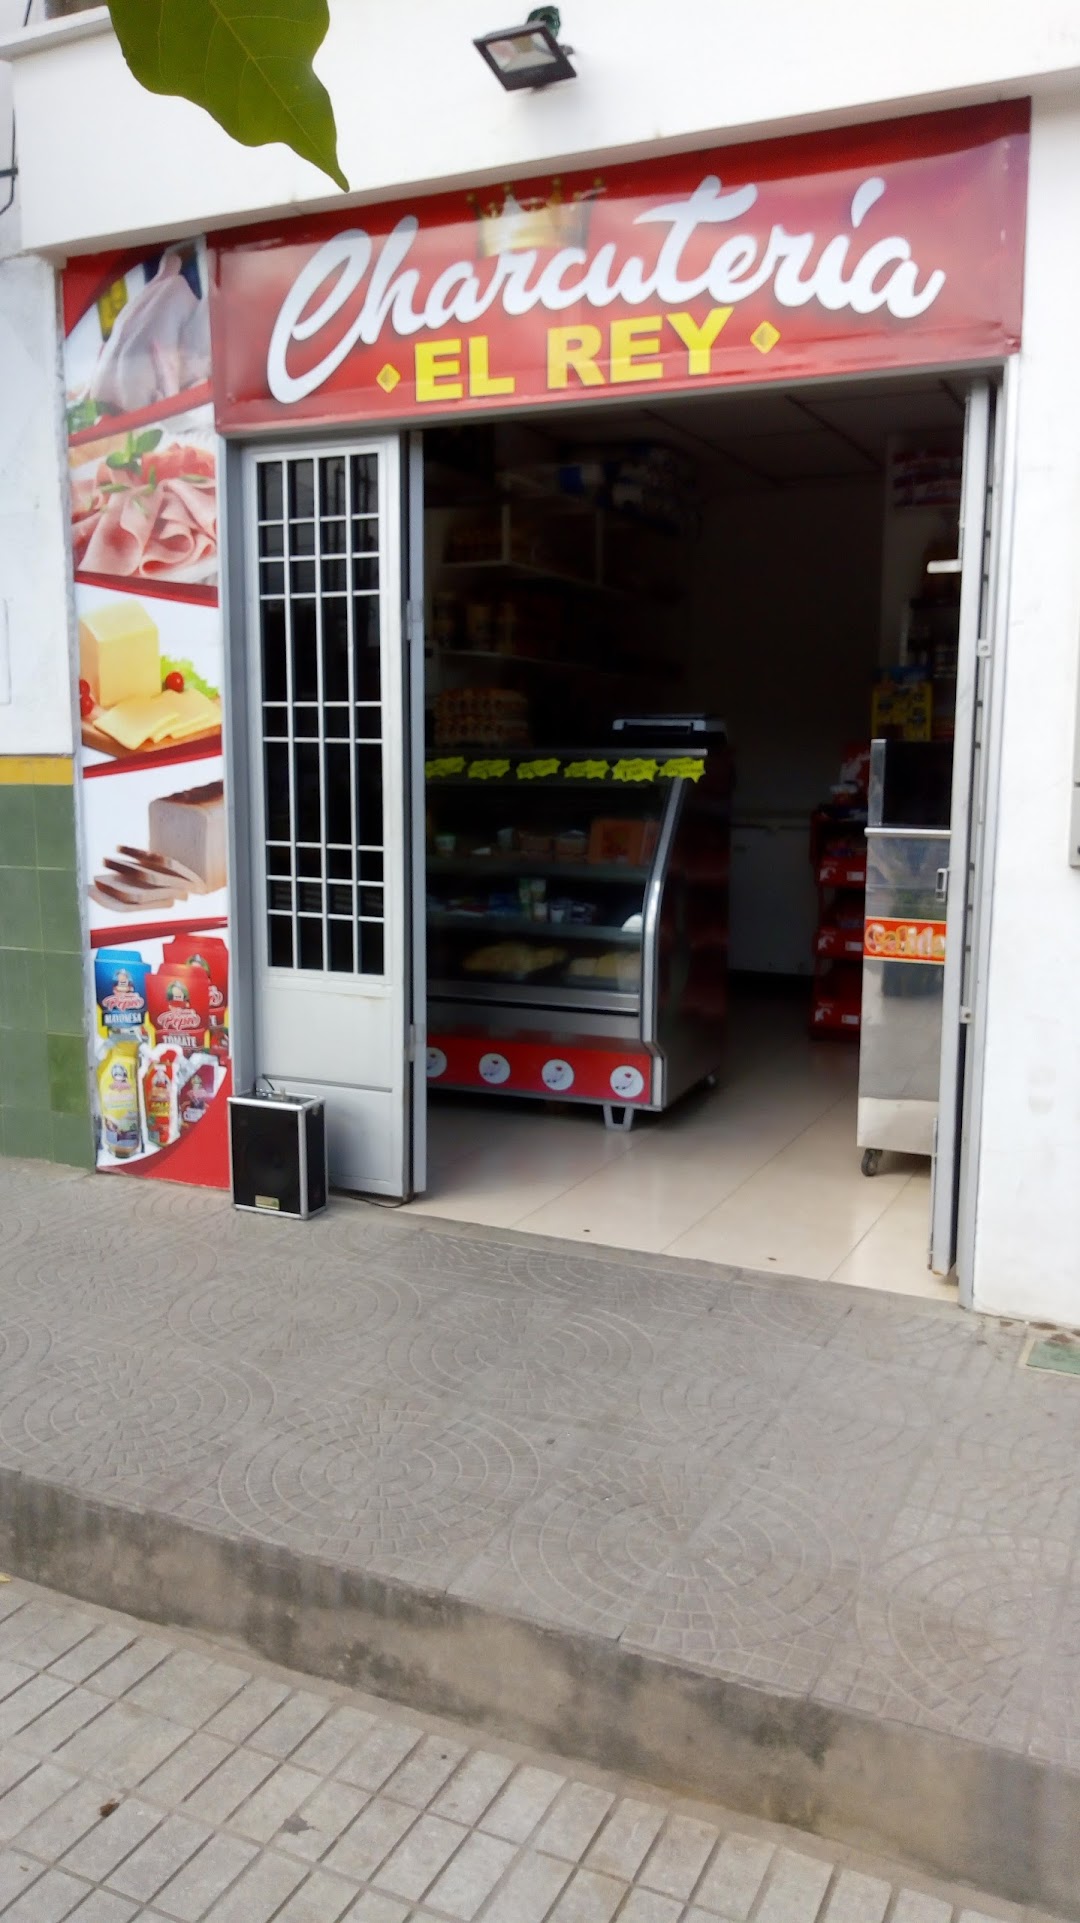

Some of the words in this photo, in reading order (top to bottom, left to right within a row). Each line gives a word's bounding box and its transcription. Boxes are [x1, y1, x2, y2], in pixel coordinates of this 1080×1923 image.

[267, 175, 946, 405] Charcutería
[414, 336, 515, 403] EL
[546, 307, 735, 389] REY
[162, 1034, 197, 1047] TOMATE
